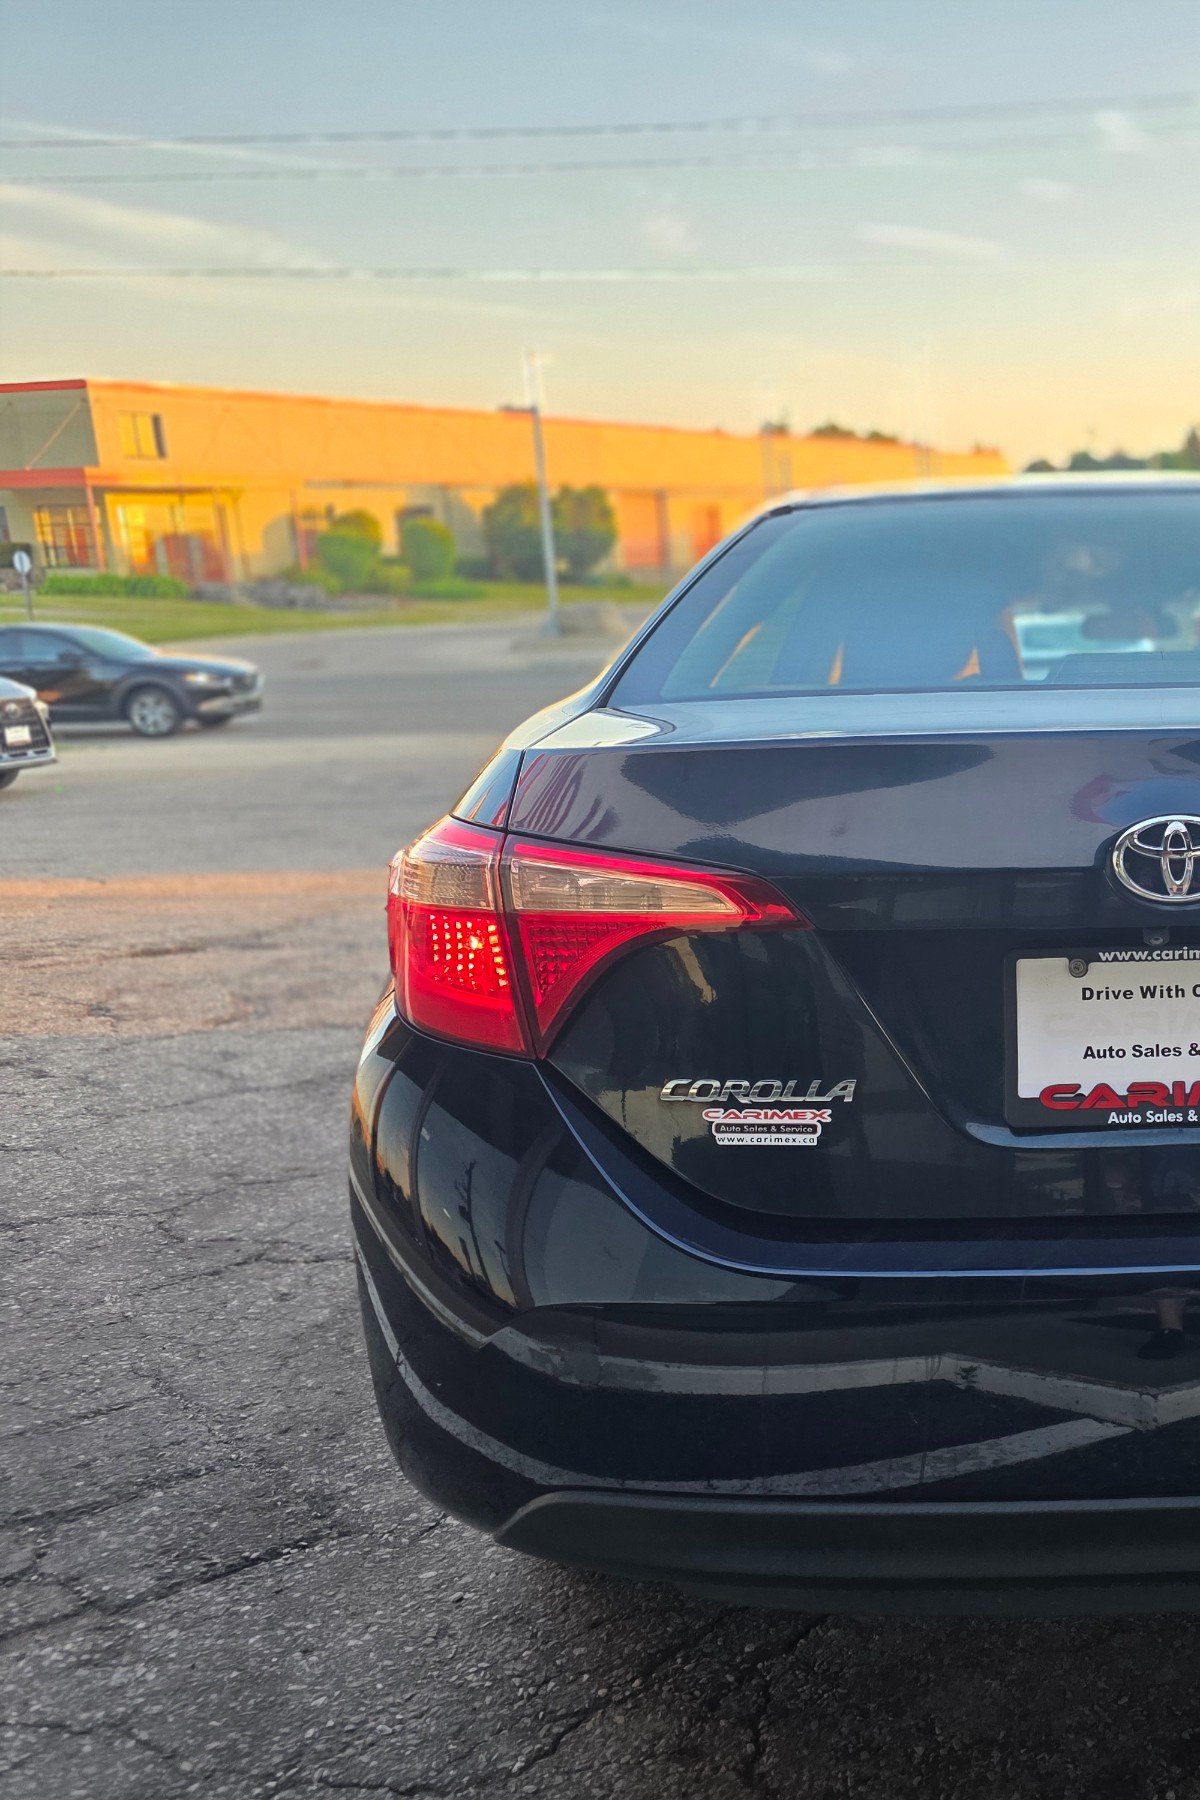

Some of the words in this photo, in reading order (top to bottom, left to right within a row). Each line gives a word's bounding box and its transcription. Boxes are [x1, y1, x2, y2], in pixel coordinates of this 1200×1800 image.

[1081, 987, 1134, 1001] Drive
[1139, 984, 1186, 999] With
[1083, 1045, 1127, 1060] Auto
[1131, 1043, 1182, 1058] Sales
[659, 1079, 857, 1104] COROLLA
[703, 1110, 831, 1120] CARIMEX
[1108, 1111, 1142, 1124] Auto
[1146, 1109, 1183, 1123] Sales
[1187, 1109, 1198, 1122] &
[720, 1124, 741, 1133] Auto
[743, 1124, 769, 1133] Sales
[770, 1124, 778, 1133] &
[779, 1124, 814, 1133] Service
[717, 1134, 815, 1144] www.carimex.ca
